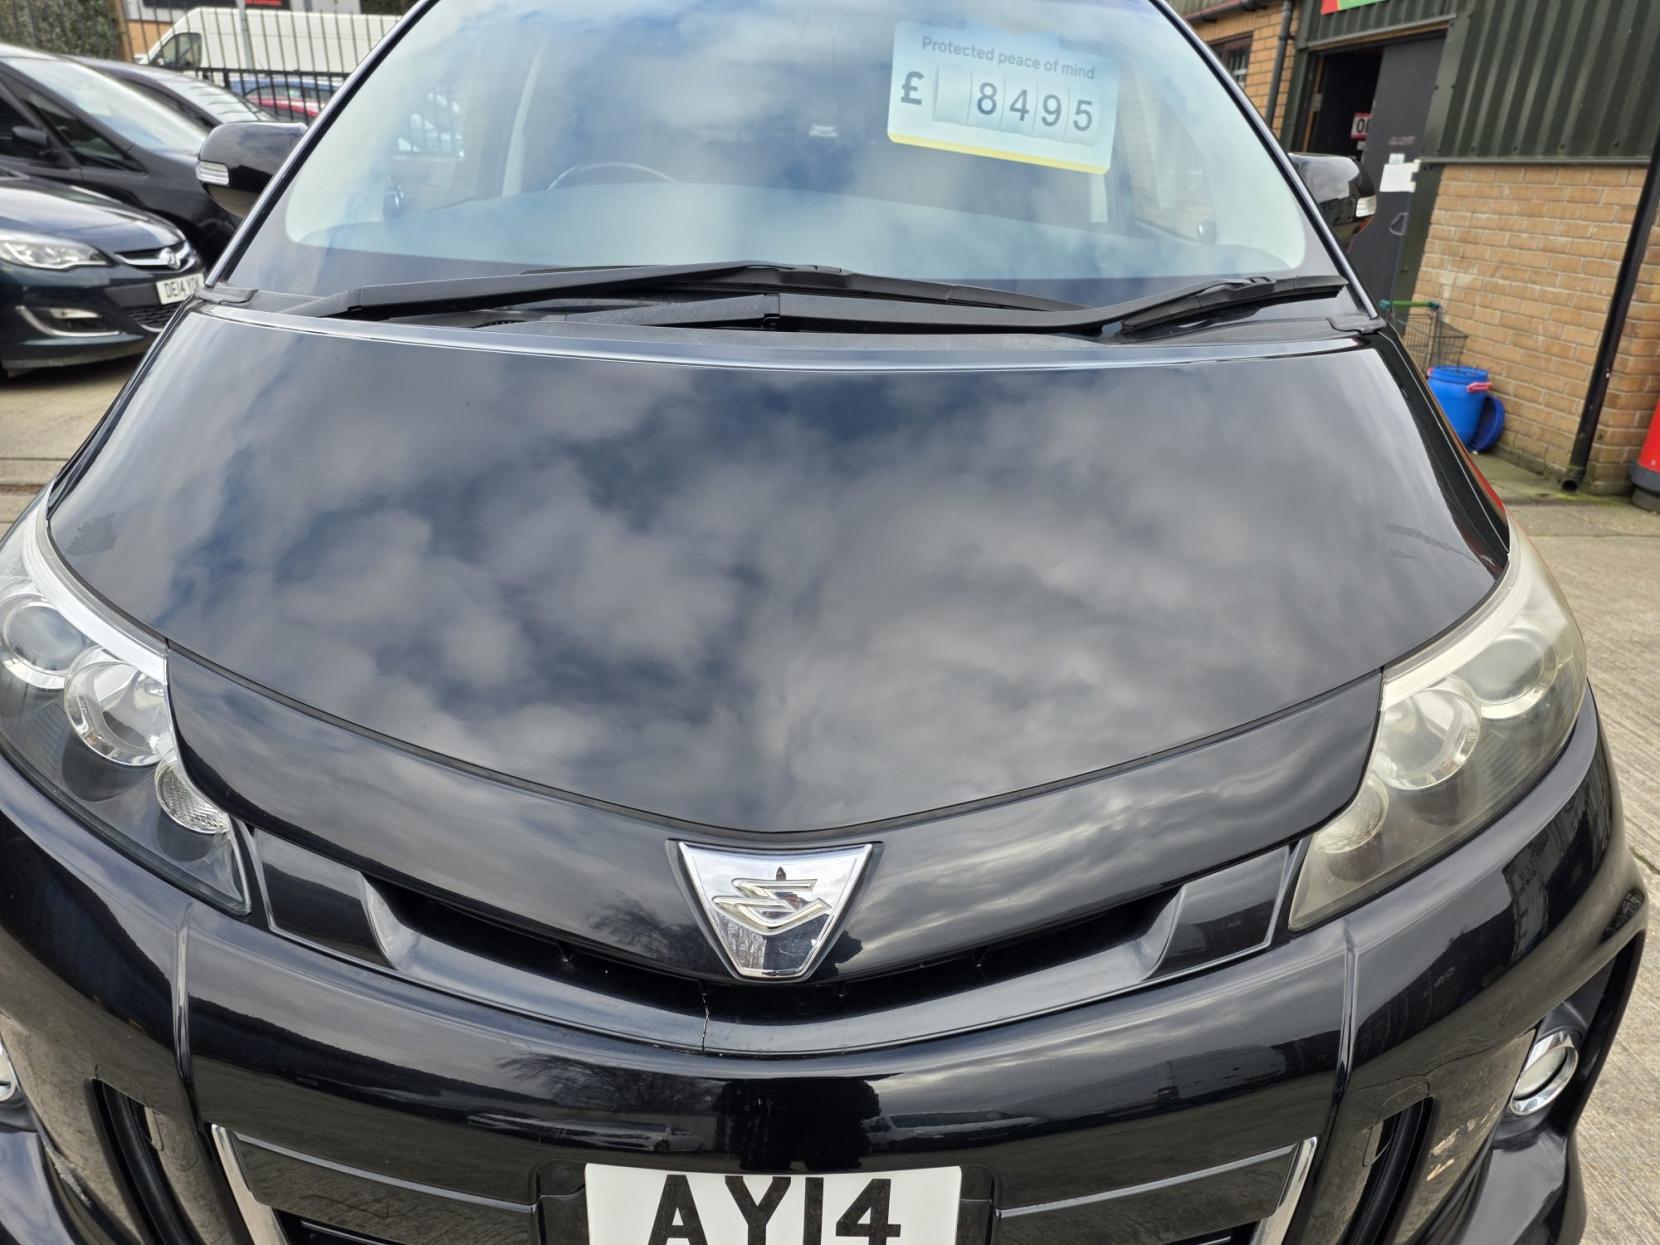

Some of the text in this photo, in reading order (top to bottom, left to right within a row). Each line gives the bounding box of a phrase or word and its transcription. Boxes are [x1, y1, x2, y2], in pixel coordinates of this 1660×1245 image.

[922, 35, 1096, 80] Protected peace of mind
[900, 71, 1093, 132] £ 8495
[648, 1174, 901, 1245] AY14
